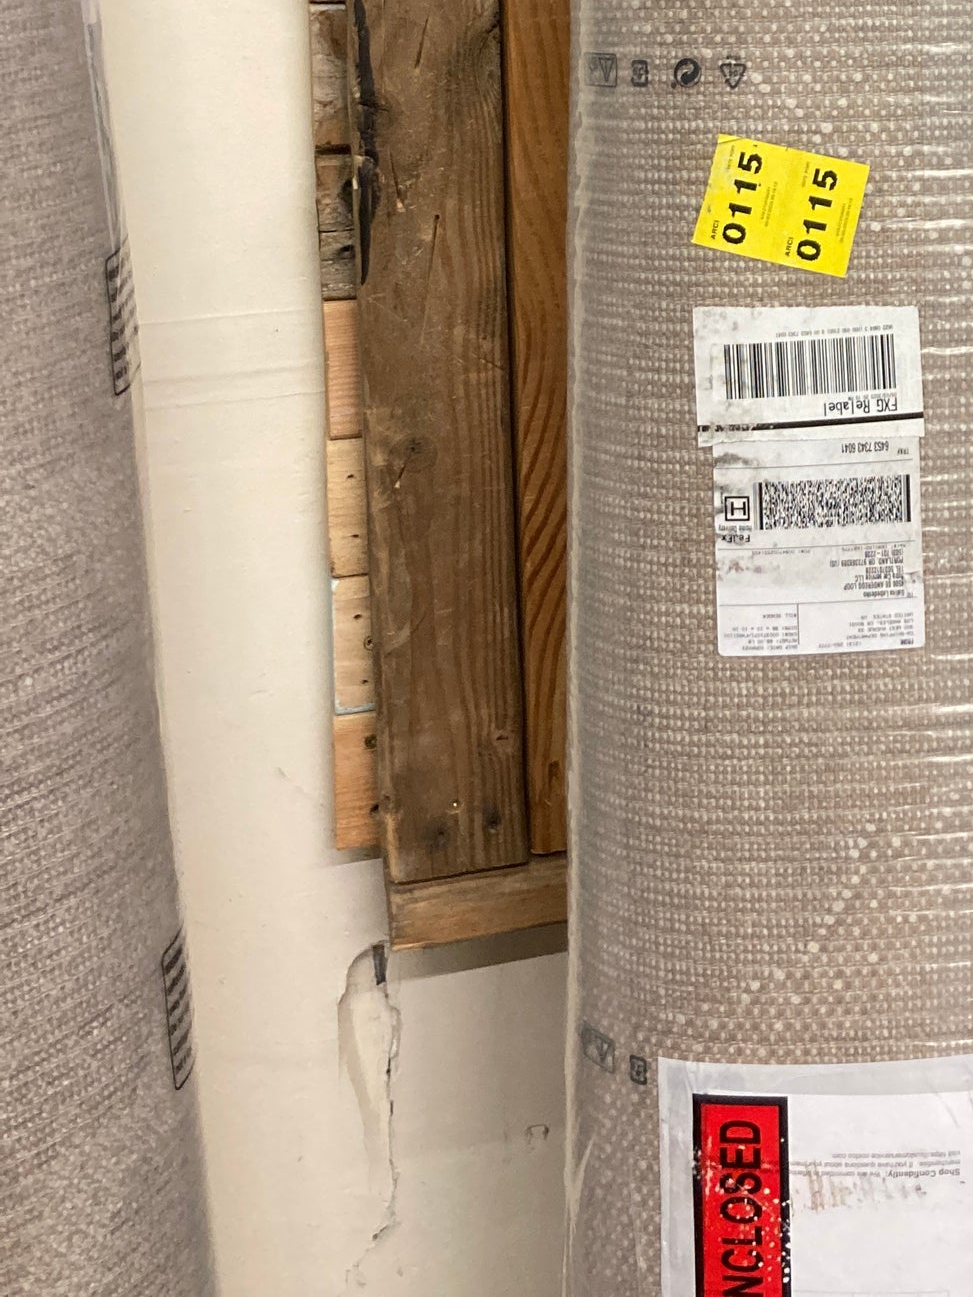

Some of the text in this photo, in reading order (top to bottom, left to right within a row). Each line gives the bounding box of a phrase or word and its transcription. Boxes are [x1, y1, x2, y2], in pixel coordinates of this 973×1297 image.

[722, 151, 763, 245] 0115
[796, 168, 838, 262] 0115
[822, 396, 898, 417] FXG Relabel
[857, 441, 872, 452] 7343
[873, 440, 889, 452] 6453
[938, 1167, 960, 1176] Shop
[719, 1119, 765, 1297] NCLOSED
